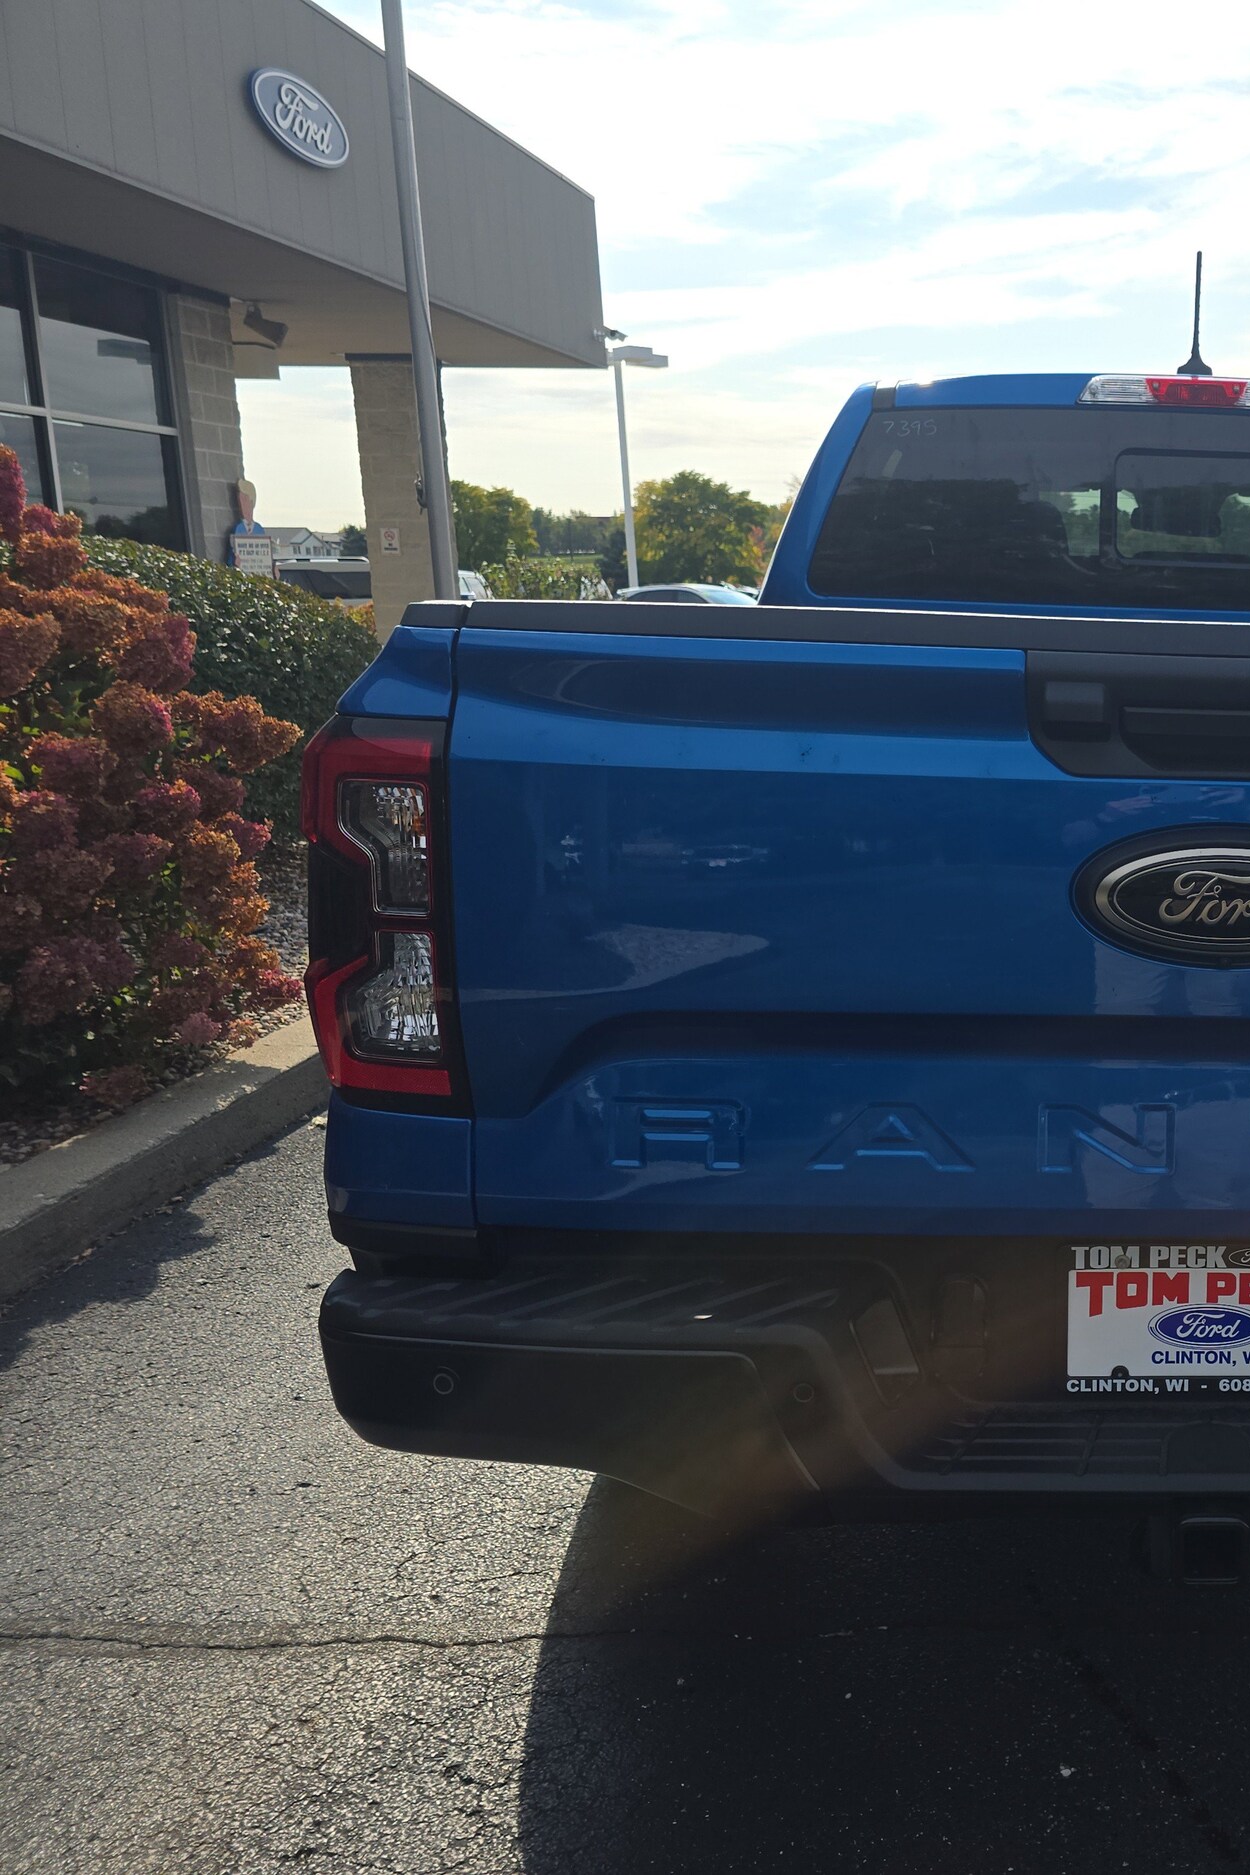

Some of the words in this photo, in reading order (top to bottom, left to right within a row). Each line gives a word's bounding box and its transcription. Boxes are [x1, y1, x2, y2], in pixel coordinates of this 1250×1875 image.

[275, 83, 333, 155] Ford
[1071, 1245, 1140, 1270] TOM
[1150, 1245, 1227, 1269] PECK
[1075, 1271, 1190, 1318] TOM
[1175, 1311, 1241, 1340] Ford
[1151, 1350, 1237, 1367] CLINTON,
[1066, 1379, 1160, 1395] CLINTON,
[1165, 1379, 1189, 1392] WI
